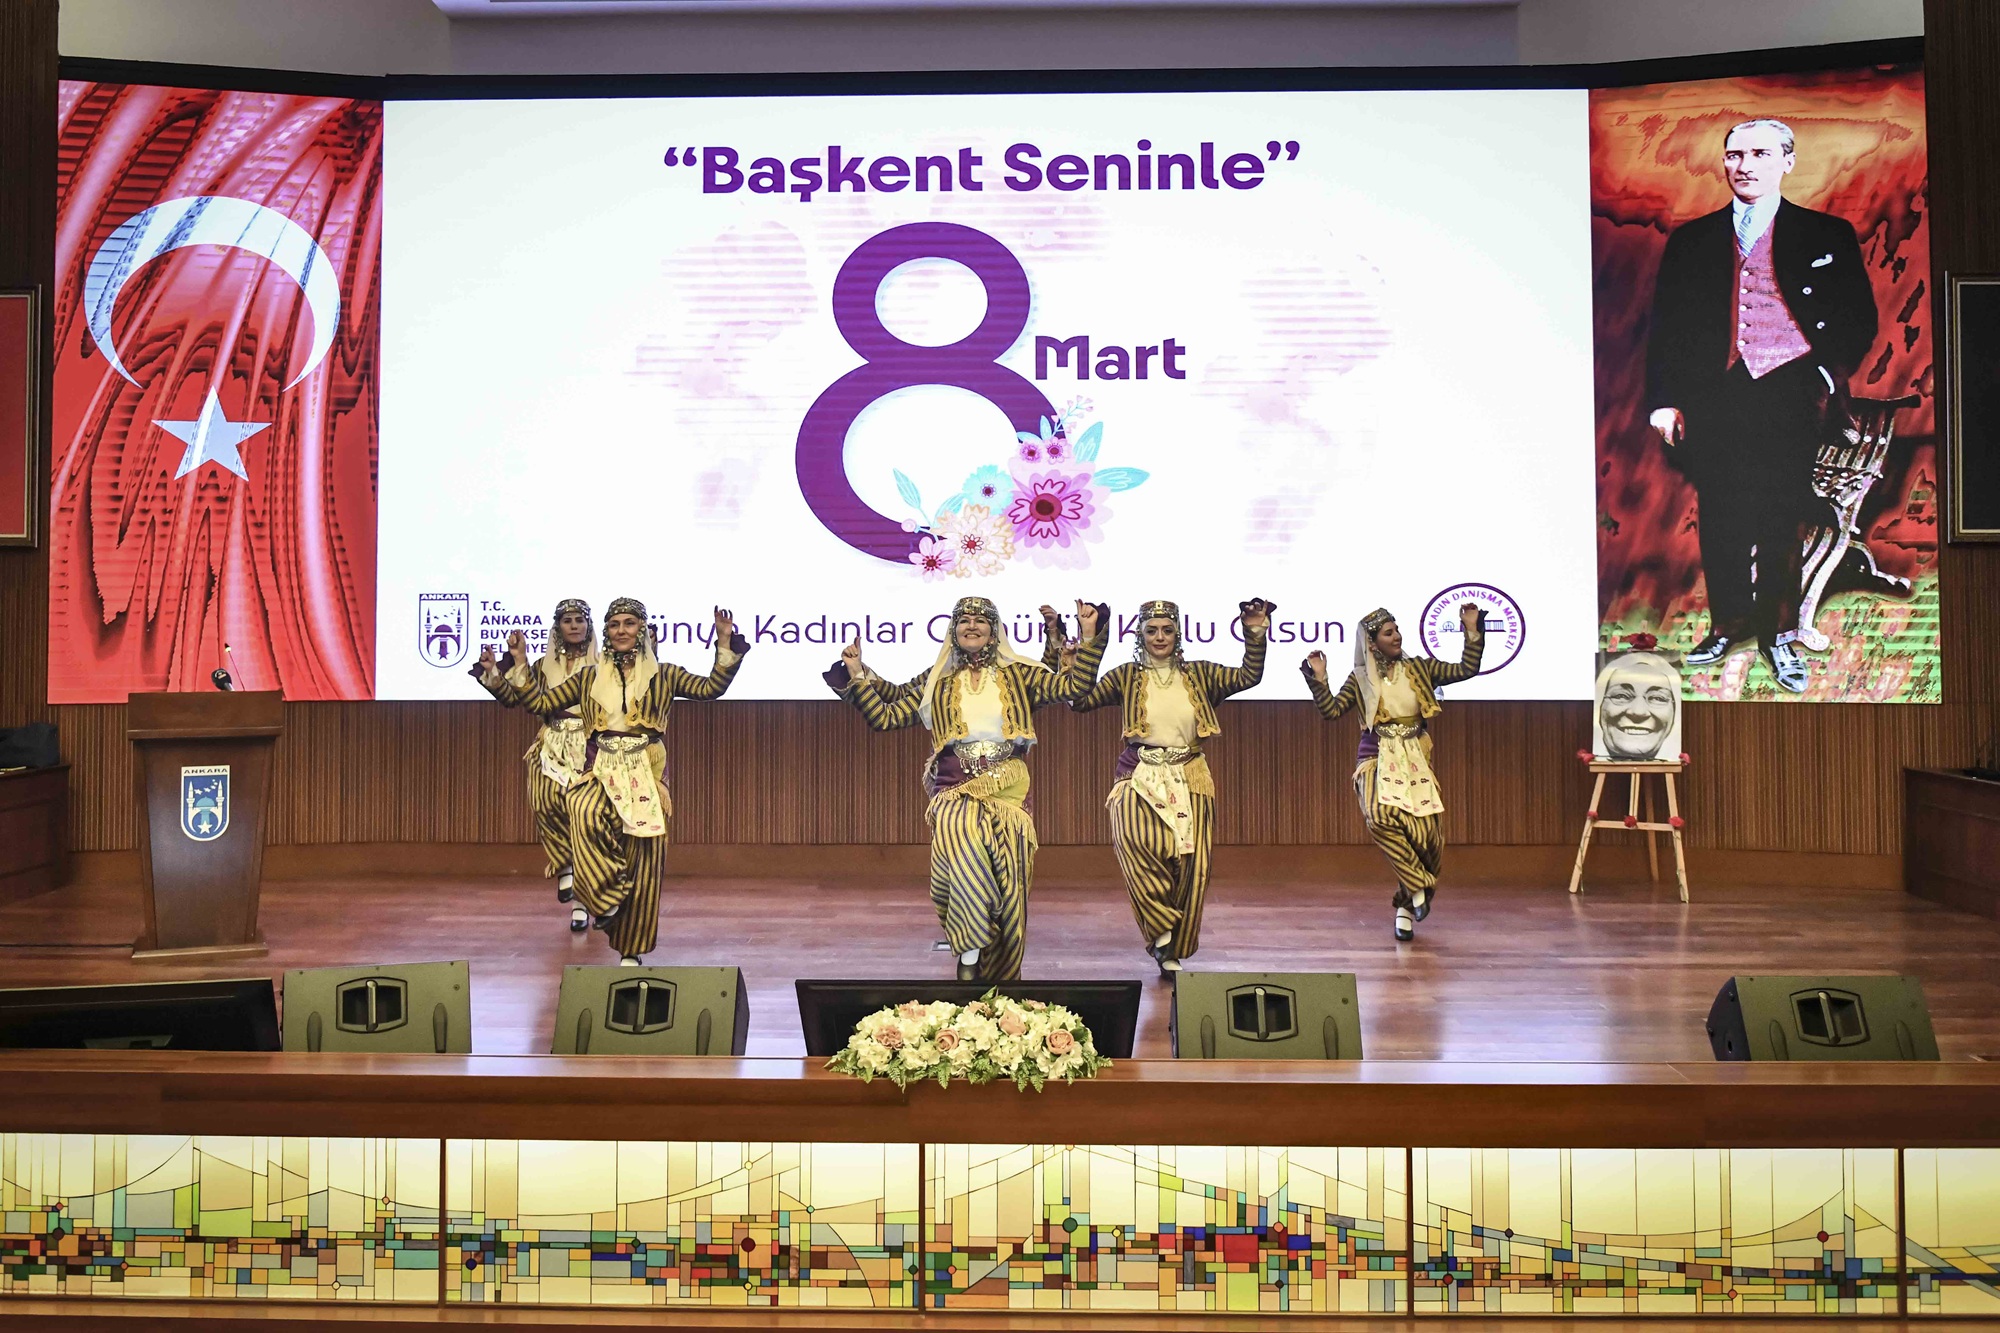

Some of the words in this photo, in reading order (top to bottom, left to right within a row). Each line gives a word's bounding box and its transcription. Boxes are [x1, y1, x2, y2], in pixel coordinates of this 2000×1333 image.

[664, 144, 984, 202] “Başkent
[1003, 139, 1300, 192] Seninle”
[795, 221, 1067, 566] 8
[1035, 335, 1187, 381] Mart
[480, 601, 506, 611] T.C.
[480, 615, 543, 625] ANKARA
[1428, 598, 1451, 627] KADIN
[649, 614, 739, 649] üny
[755, 614, 914, 643] Kadınlar
[1118, 614, 1216, 643] Klu
[1428, 630, 1442, 649] ABB
